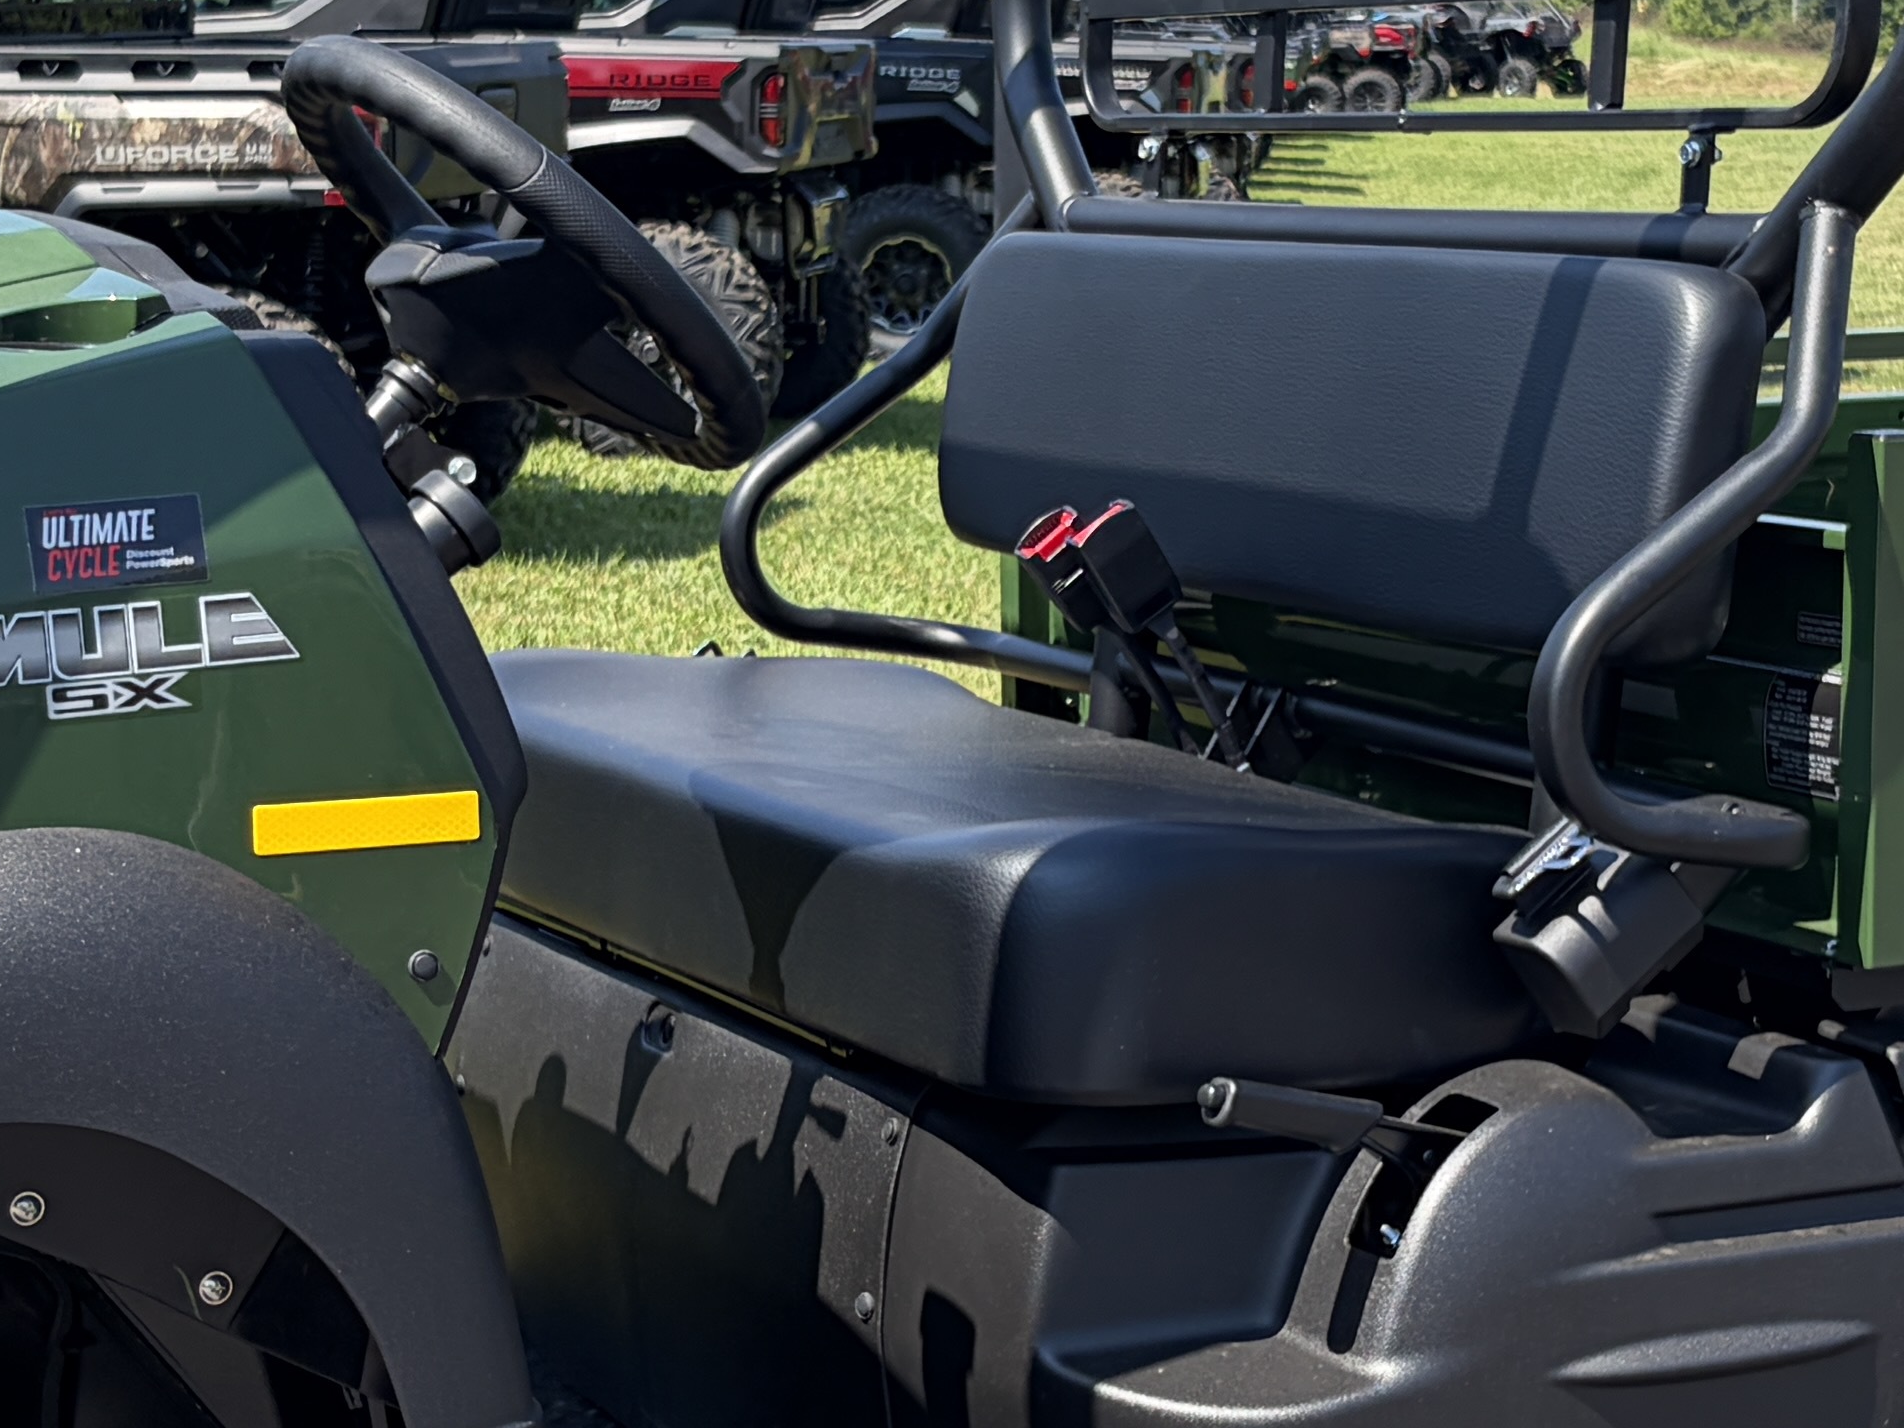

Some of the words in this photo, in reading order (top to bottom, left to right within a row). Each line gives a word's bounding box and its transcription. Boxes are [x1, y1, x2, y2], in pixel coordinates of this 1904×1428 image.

[609, 73, 712, 87] RIDGE
[42, 508, 156, 550] ULTIMATE
[48, 544, 121, 582] CYCLE
[125, 546, 175, 560] Discount
[125, 555, 195, 570] PowerSports
[46, 671, 193, 721] SX
